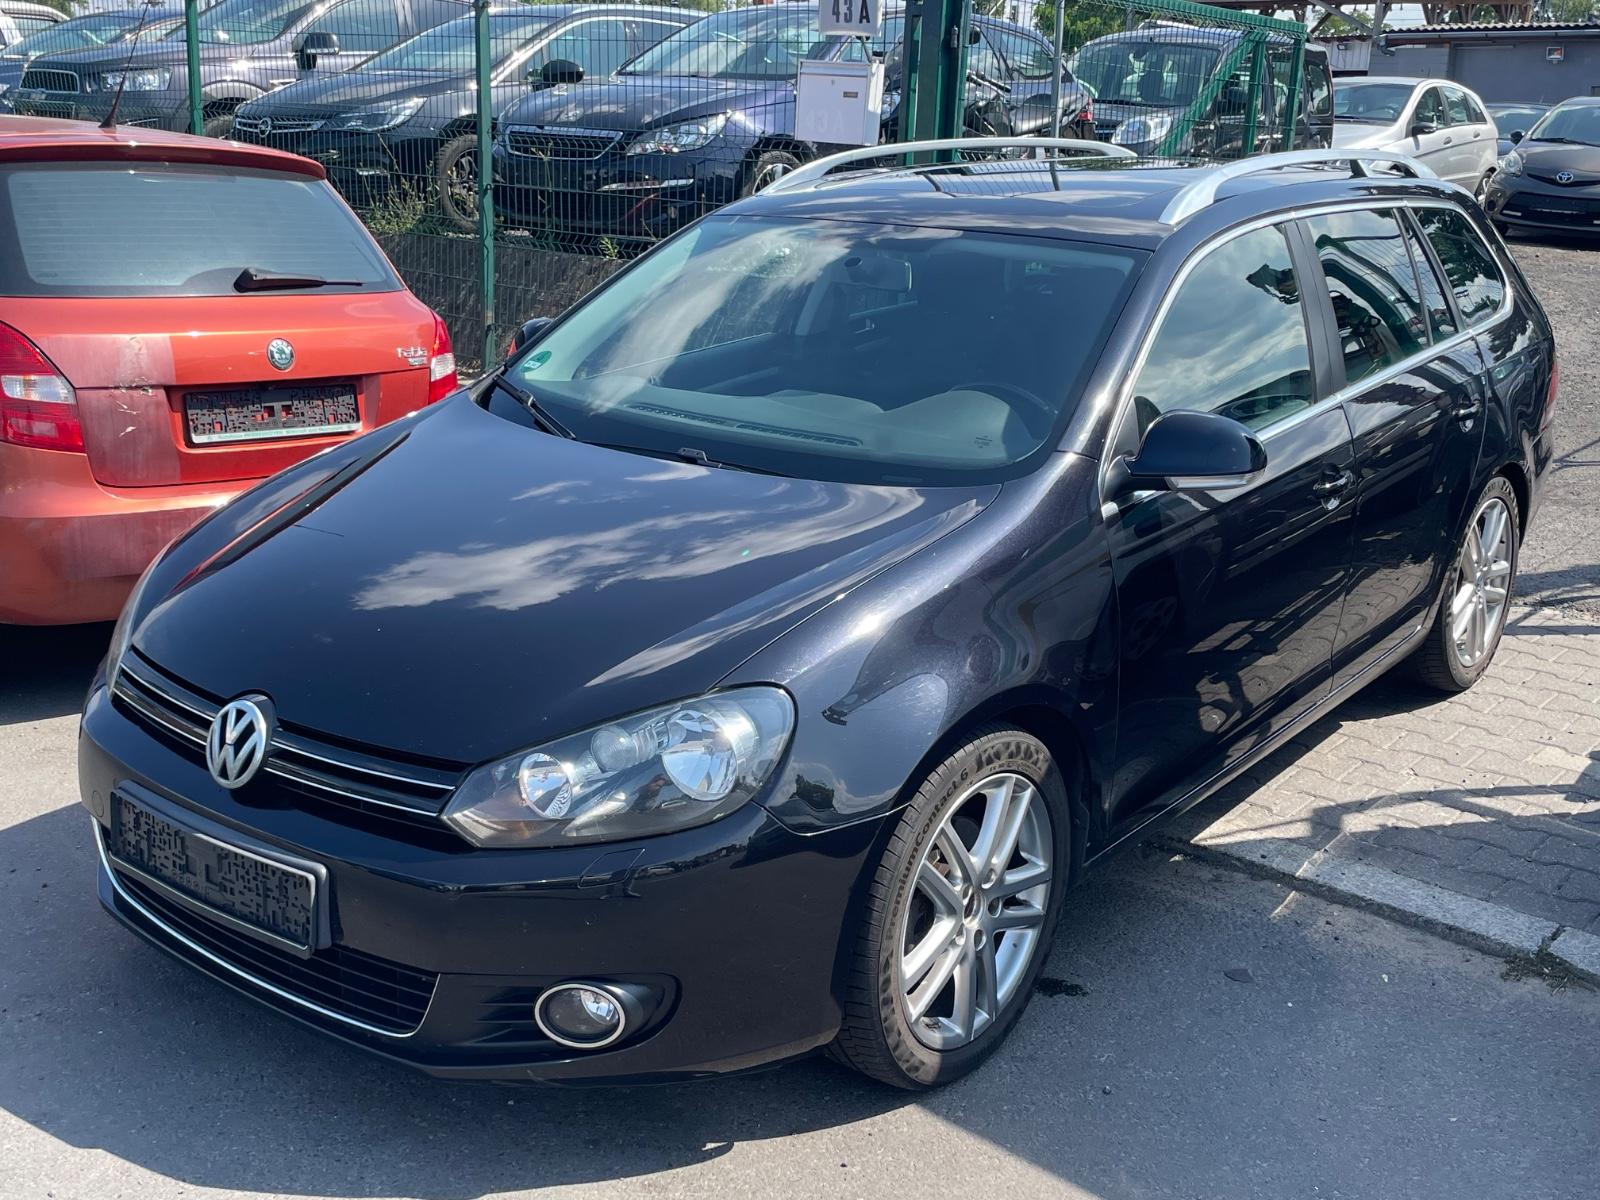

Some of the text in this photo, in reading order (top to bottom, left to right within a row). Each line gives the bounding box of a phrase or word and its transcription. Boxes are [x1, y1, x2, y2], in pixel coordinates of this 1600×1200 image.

[832, 0, 871, 24] 43 A
[960, 767, 969, 780] 6
